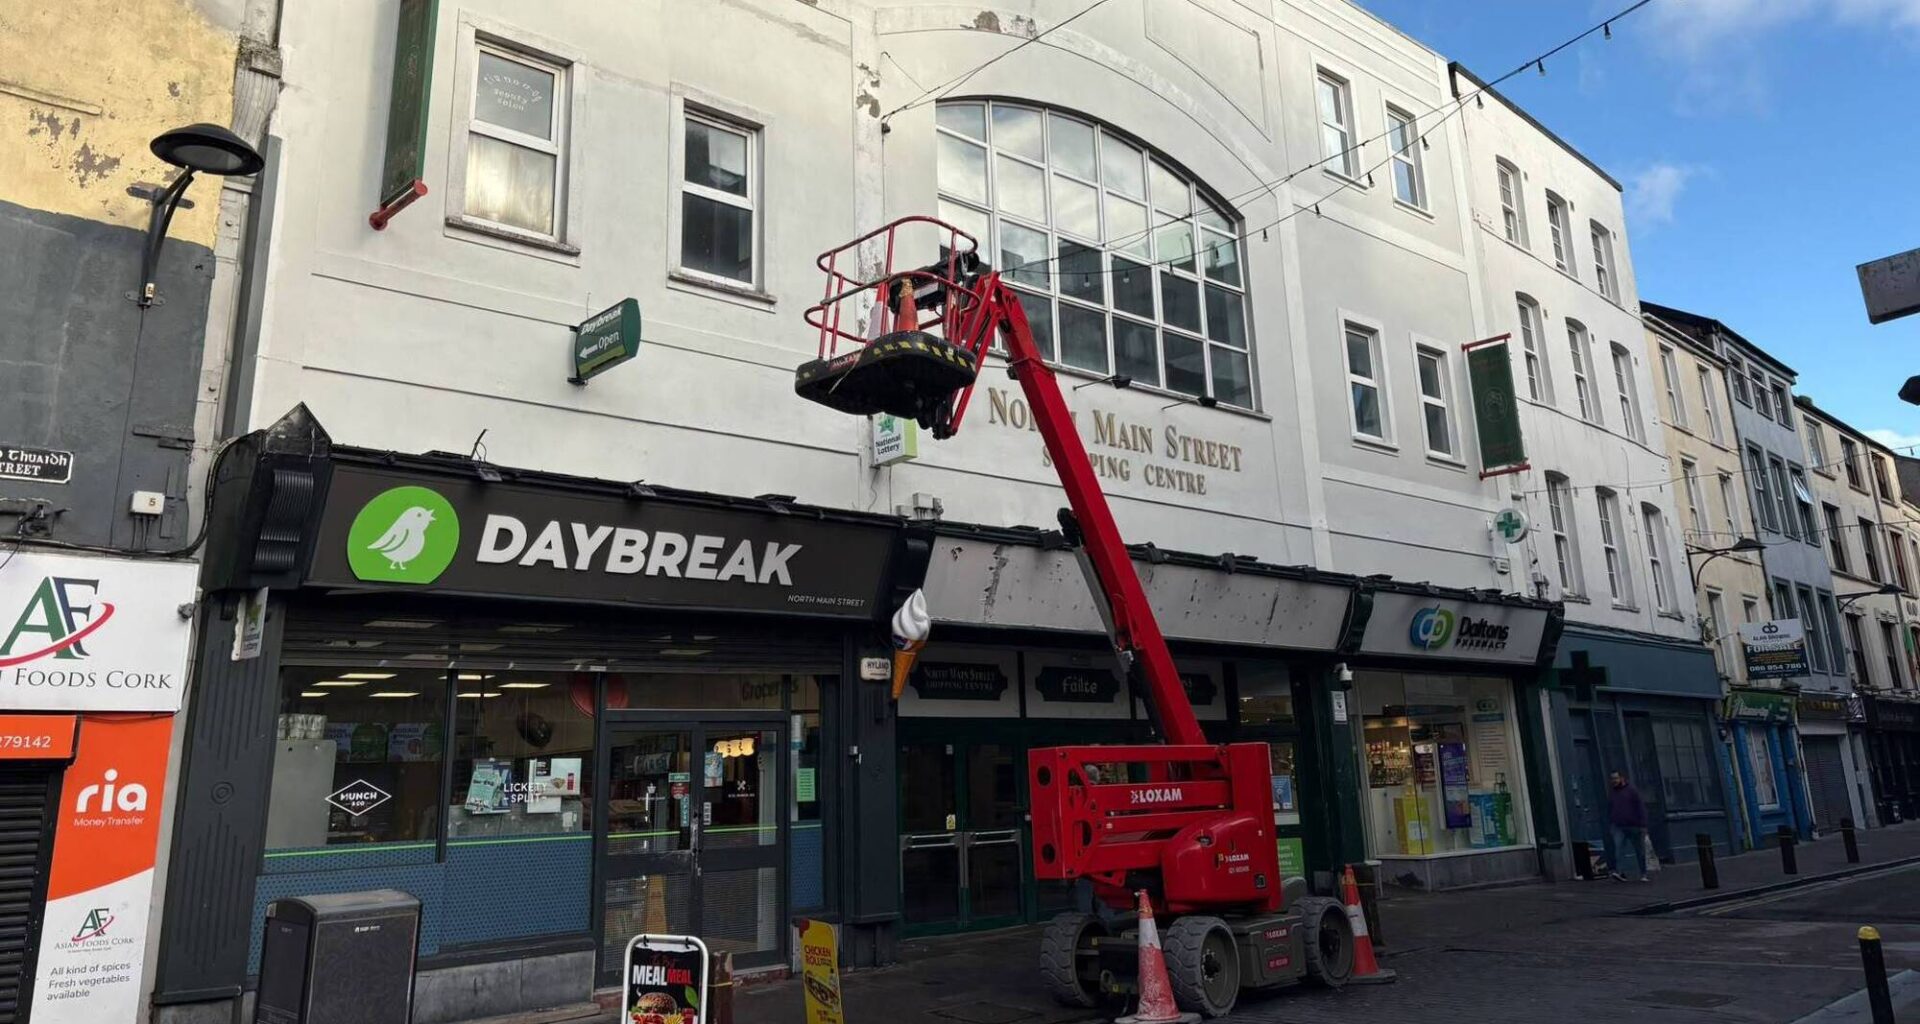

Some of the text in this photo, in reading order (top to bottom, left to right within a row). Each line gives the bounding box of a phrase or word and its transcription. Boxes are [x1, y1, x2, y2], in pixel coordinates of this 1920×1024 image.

[581, 305, 623, 335] Daybreak
[598, 331, 619, 350] Open
[876, 433, 901, 447] National
[877, 443, 900, 455] Lottery
[1042, 446, 1207, 495] SPING CENTRE
[476, 513, 803, 586] DAYBREAK
[787, 594, 865, 607] NORTH MAIN STREET
[1459, 616, 1510, 640] Daltons
[1456, 638, 1507, 650] PHARMACY
[76, 769, 147, 812] ria
[503, 782, 547, 793] LICKETY
[340, 791, 378, 801] MUNCH
[1139, 788, 1183, 803] LOXAM
[74, 816, 144, 828] Money Transfer
[50, 962, 131, 976] All kind of spices
[632, 965, 667, 986] MEAL
[48, 975, 130, 989] Fresh vegetables
[47, 989, 90, 1001] available
